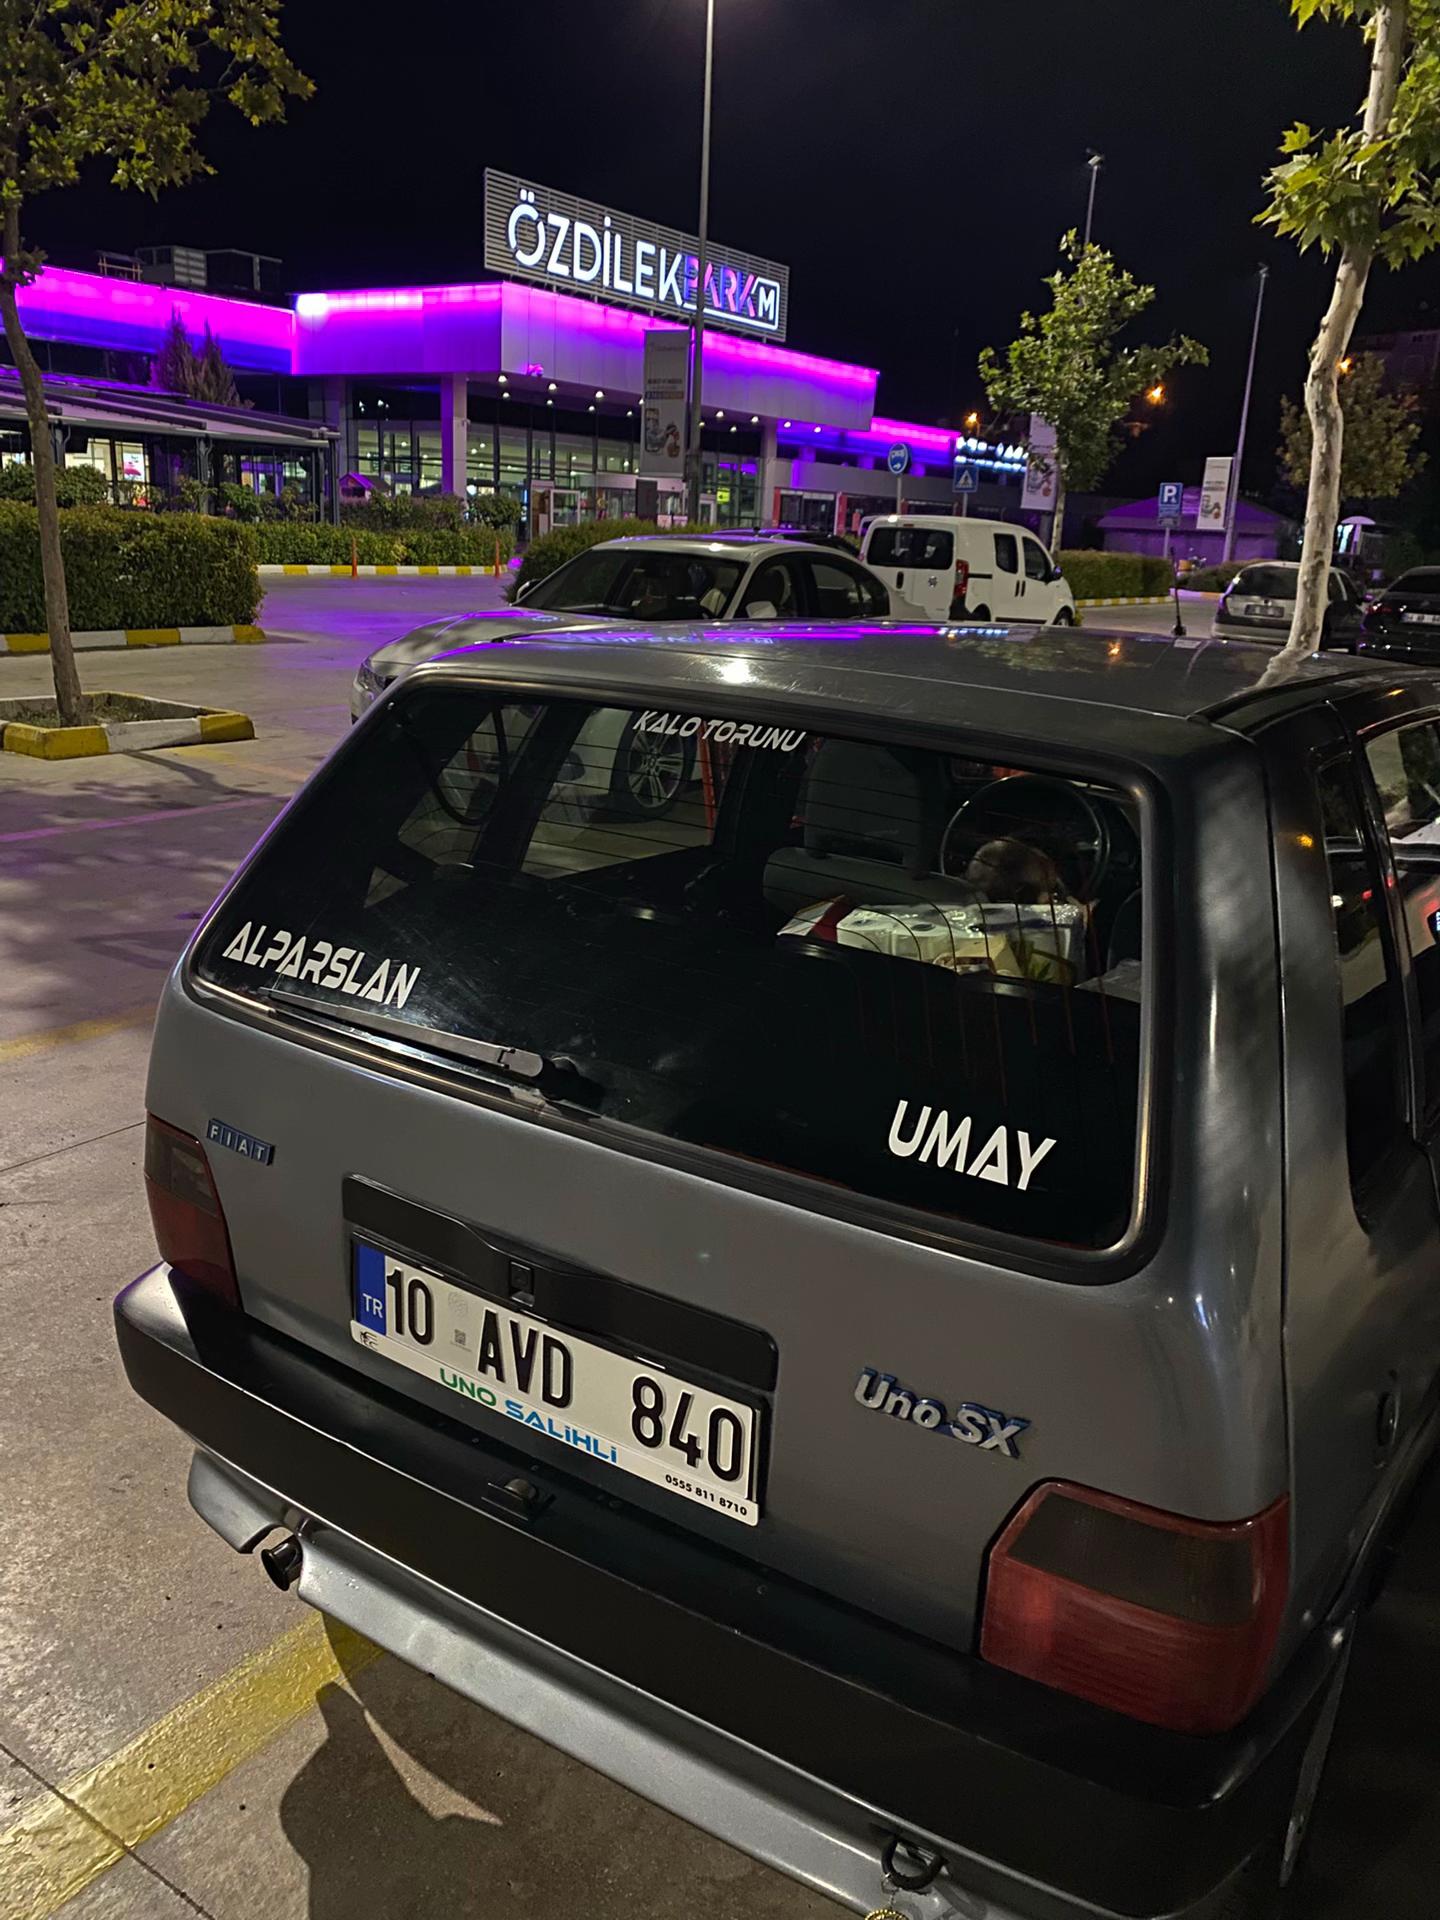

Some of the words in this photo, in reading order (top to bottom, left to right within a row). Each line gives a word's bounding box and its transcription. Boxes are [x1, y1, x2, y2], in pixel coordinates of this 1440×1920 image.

[1163, 485, 1177, 503] P
[633, 710, 701, 737] KALO
[701, 719, 806, 752] TORUNU
[222, 921, 421, 1009] ALPARSLAN
[210, 1124, 265, 1161] FIAT
[888, 1100, 1057, 1191] UMAY
[362, 1293, 383, 1318] TR
[386, 1268, 434, 1346] 10
[478, 1308, 574, 1410] AVD
[631, 1375, 745, 1483] 840
[440, 1367, 497, 1407] UNO
[854, 1367, 947, 1430] Uno
[950, 1402, 1031, 1459] SX
[665, 1474, 692, 1492] 0555
[695, 1487, 715, 1503] 811
[719, 1497, 748, 1516] 8710
